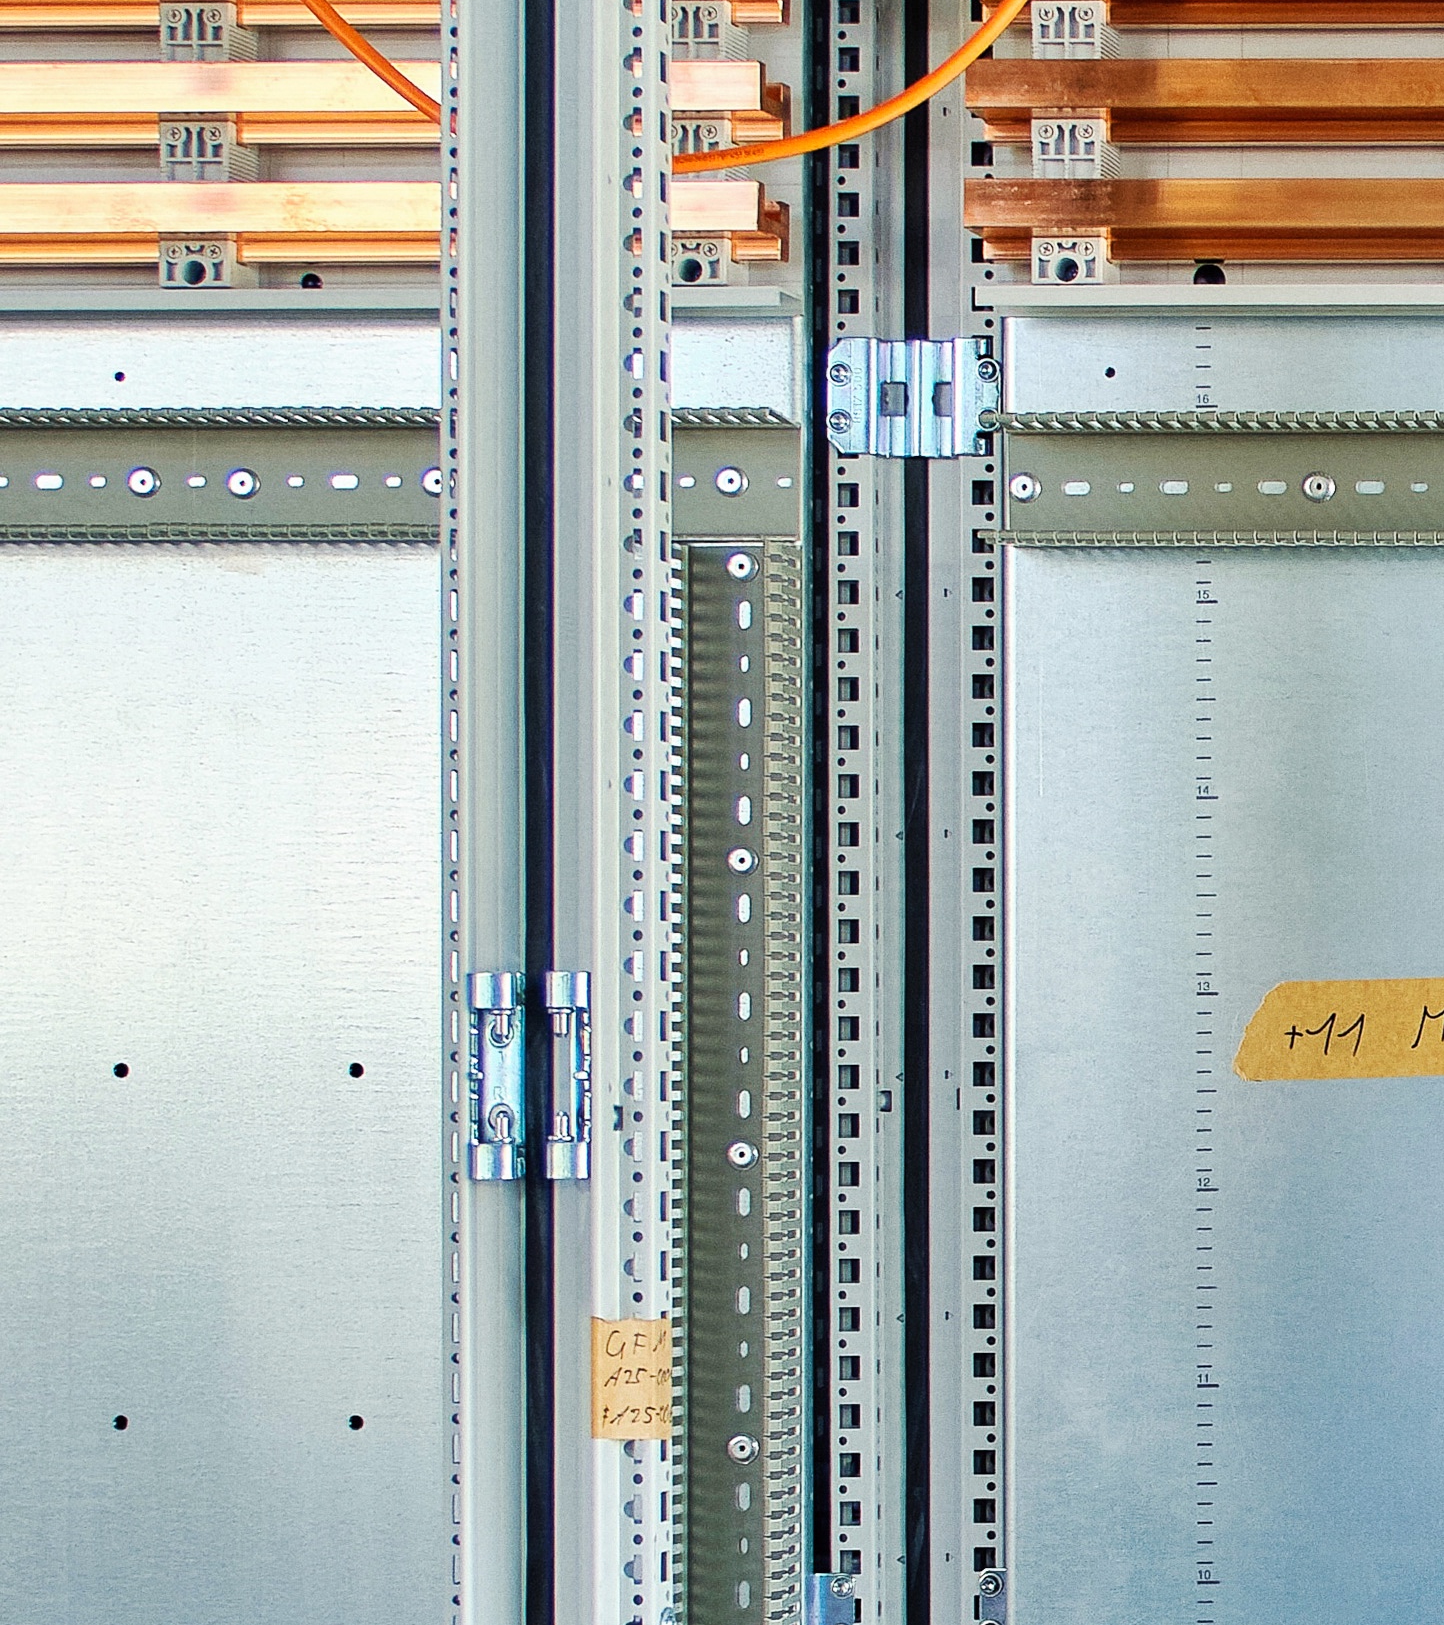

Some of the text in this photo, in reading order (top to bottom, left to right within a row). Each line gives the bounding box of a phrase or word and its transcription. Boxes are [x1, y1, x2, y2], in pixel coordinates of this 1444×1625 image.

[1196, 394, 1210, 405] 16
[1196, 590, 1210, 601] 15
[1196, 786, 1210, 797] 14
[1196, 982, 1210, 993] 13
[1197, 1178, 1211, 1189] 12
[1197, 1374, 1211, 1385] 11
[1198, 1570, 1212, 1581] 10
